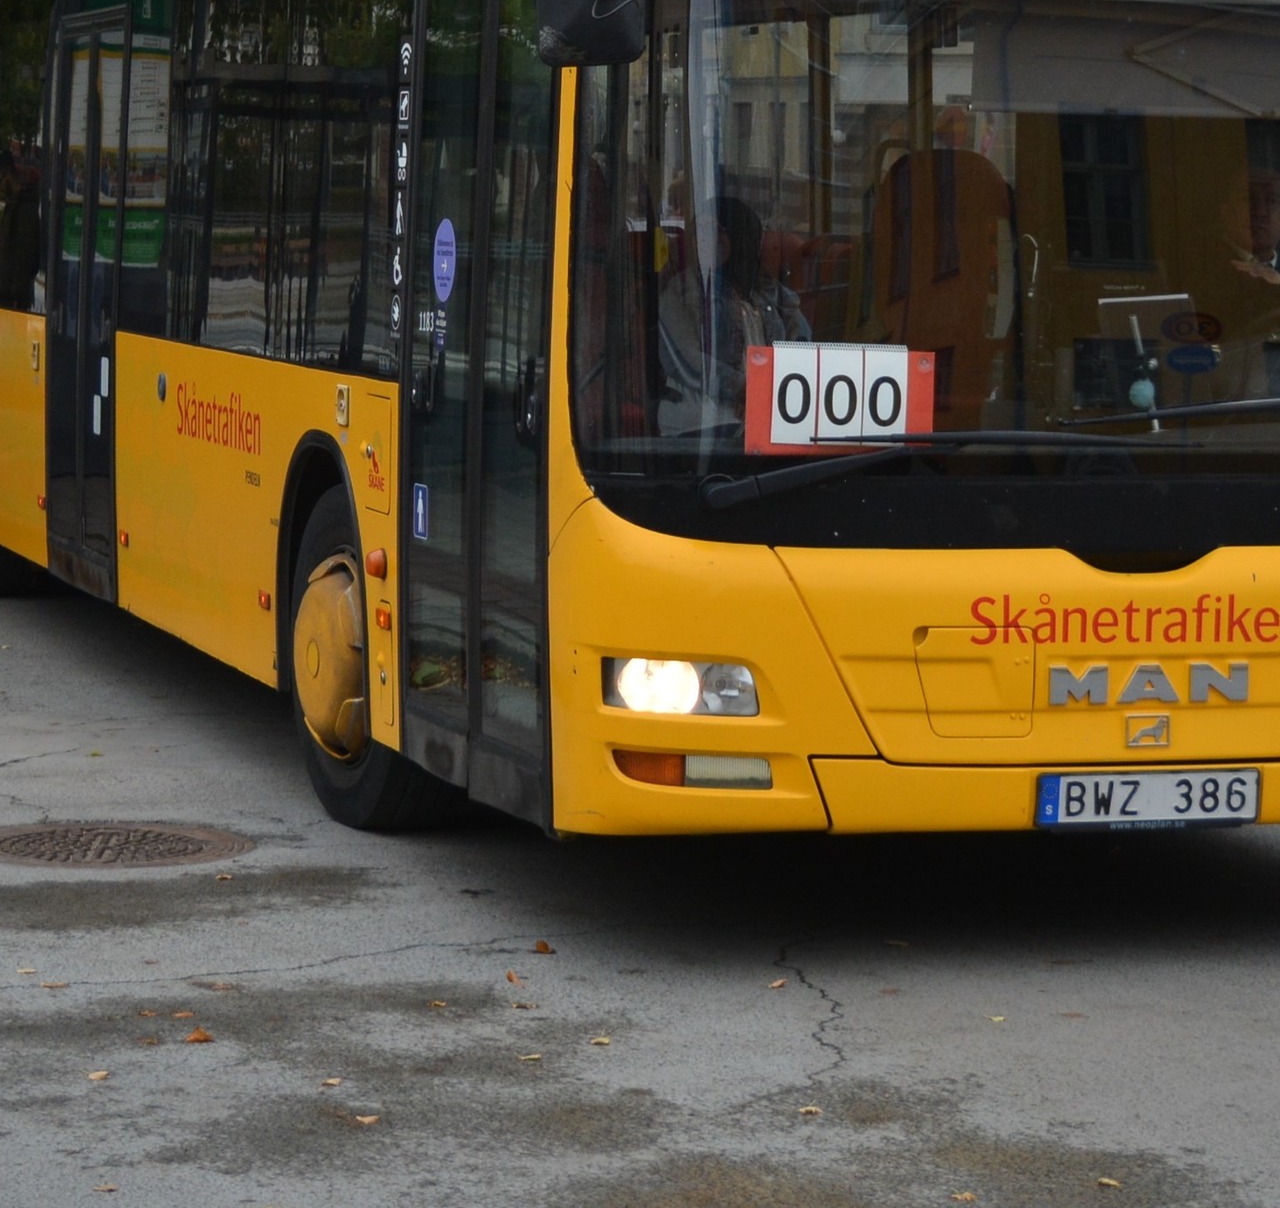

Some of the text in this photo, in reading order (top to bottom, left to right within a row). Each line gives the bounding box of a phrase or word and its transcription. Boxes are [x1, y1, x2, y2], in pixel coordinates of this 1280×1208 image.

[419, 312, 434, 332] 1183
[177, 381, 261, 455] Skånetrafiken
[777, 373, 901, 426] 000
[1048, 660, 1249, 705] MAN
[1045, 805, 1053, 815] S
[1065, 777, 1247, 817] BWZ 386
[1109, 820, 1186, 830] www.neoplan.se
